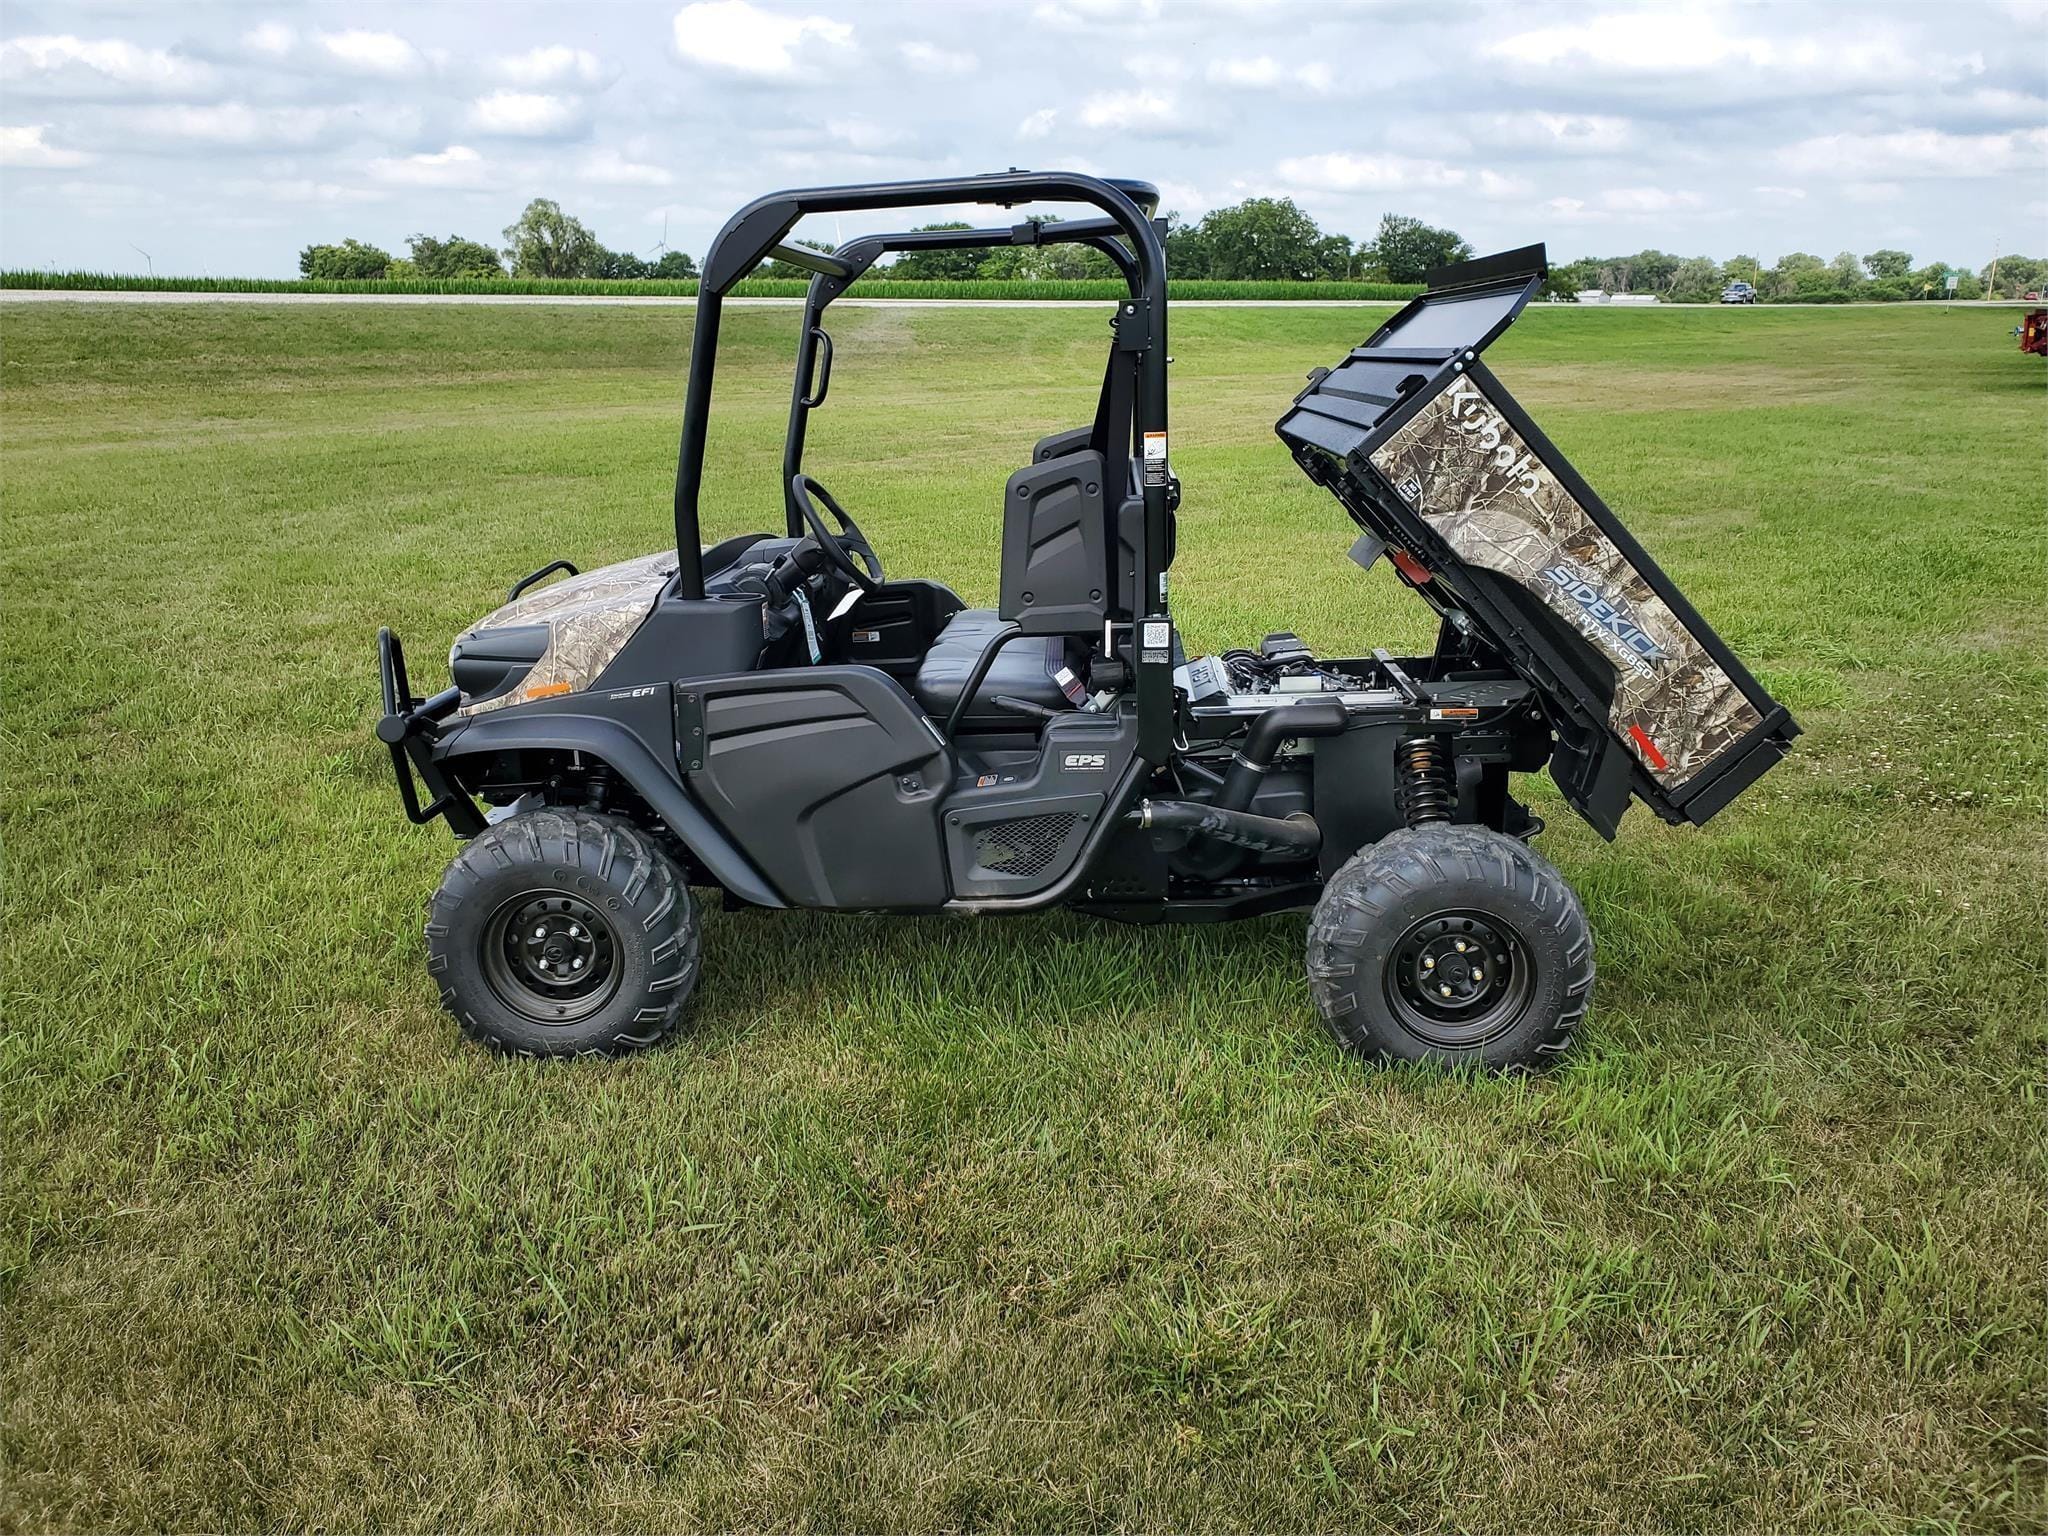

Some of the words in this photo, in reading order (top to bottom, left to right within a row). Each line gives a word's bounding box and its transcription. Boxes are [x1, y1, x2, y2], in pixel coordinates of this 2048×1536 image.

[1446, 378, 1540, 498] Kubota
[1401, 484, 1415, 497] STEP
[1544, 565, 1672, 670] SIDEKICK
[1580, 612, 1653, 680] RTV-XG850
[632, 687, 656, 697] EFI
[1064, 754, 1106, 767] EPS
